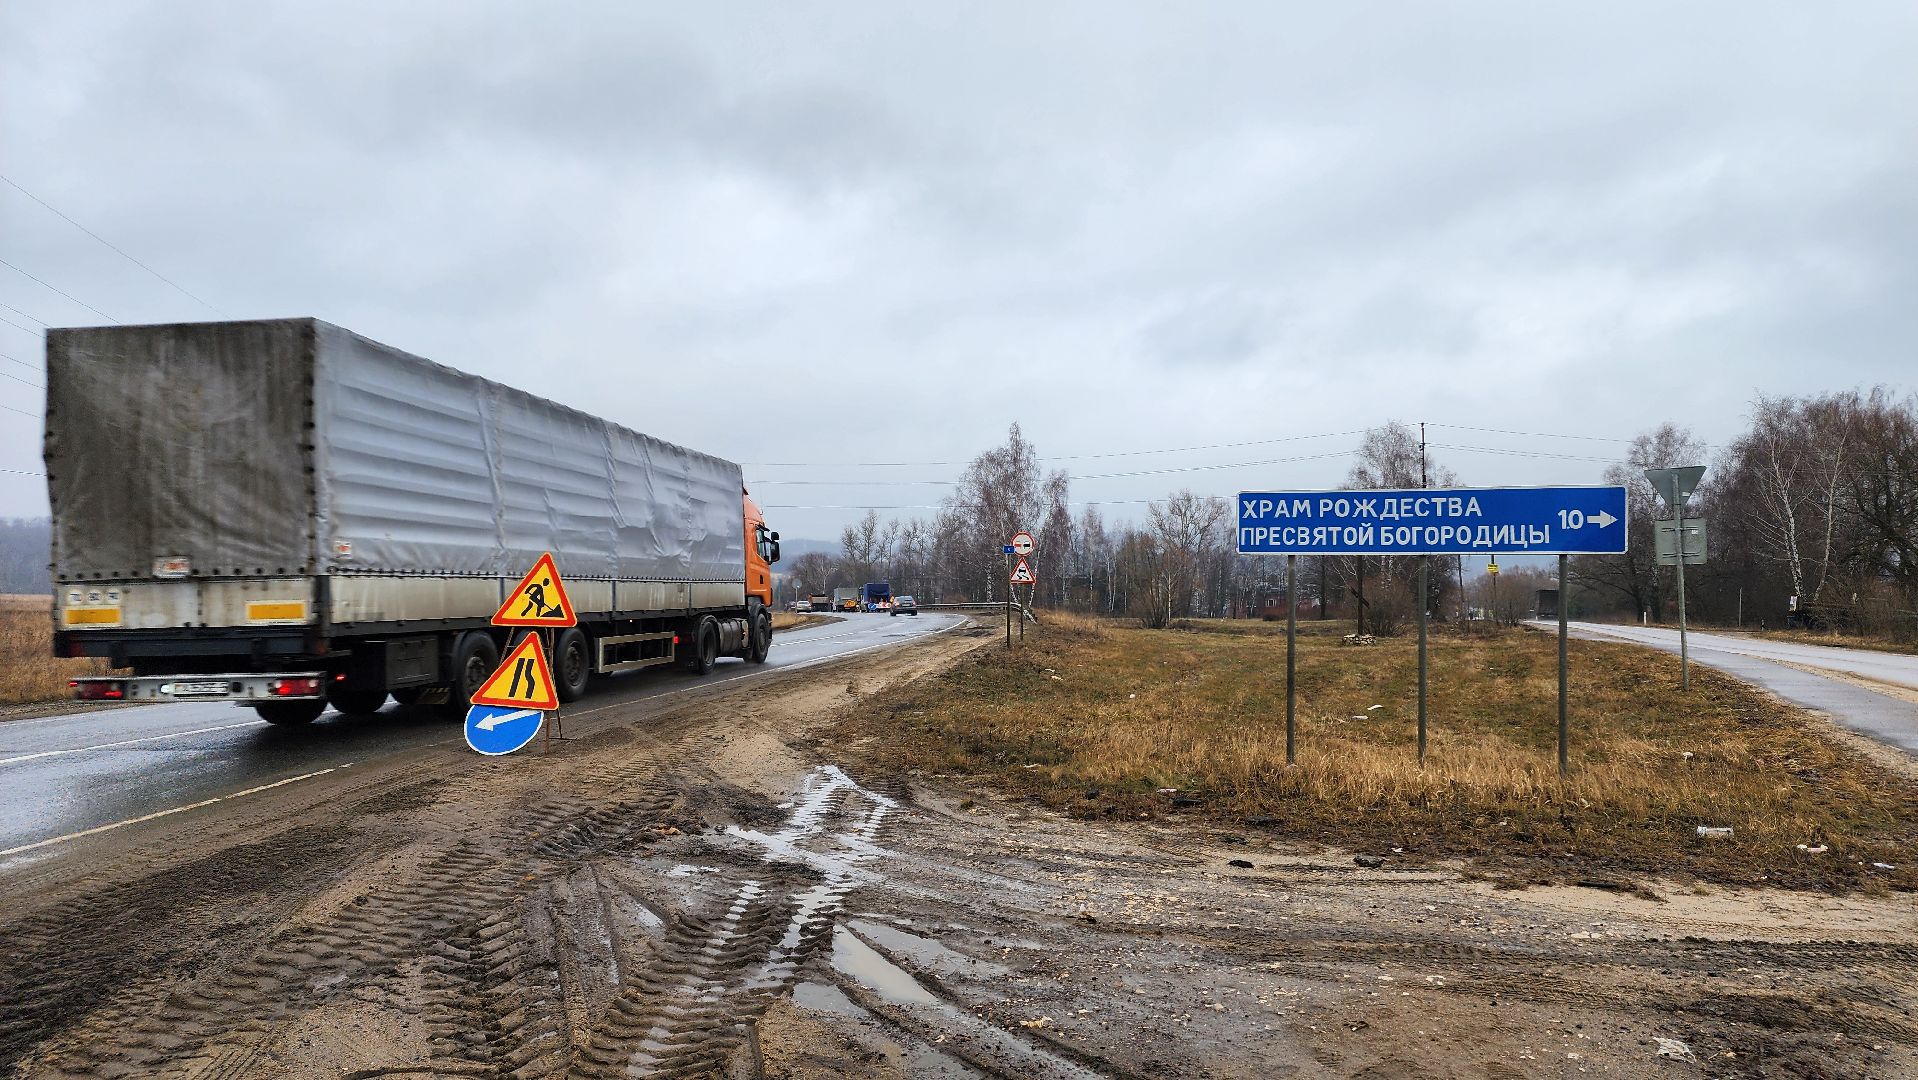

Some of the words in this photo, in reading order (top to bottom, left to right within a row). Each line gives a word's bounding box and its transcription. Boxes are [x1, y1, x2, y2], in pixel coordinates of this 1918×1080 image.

[1242, 499, 1312, 519] ХРАМ
[1319, 497, 1482, 520] РОЖДЕСТВА
[1240, 523, 1374, 546] ПРЕСВЯТОЙ
[1380, 525, 1550, 548] БОГОРОДИЦЫ
